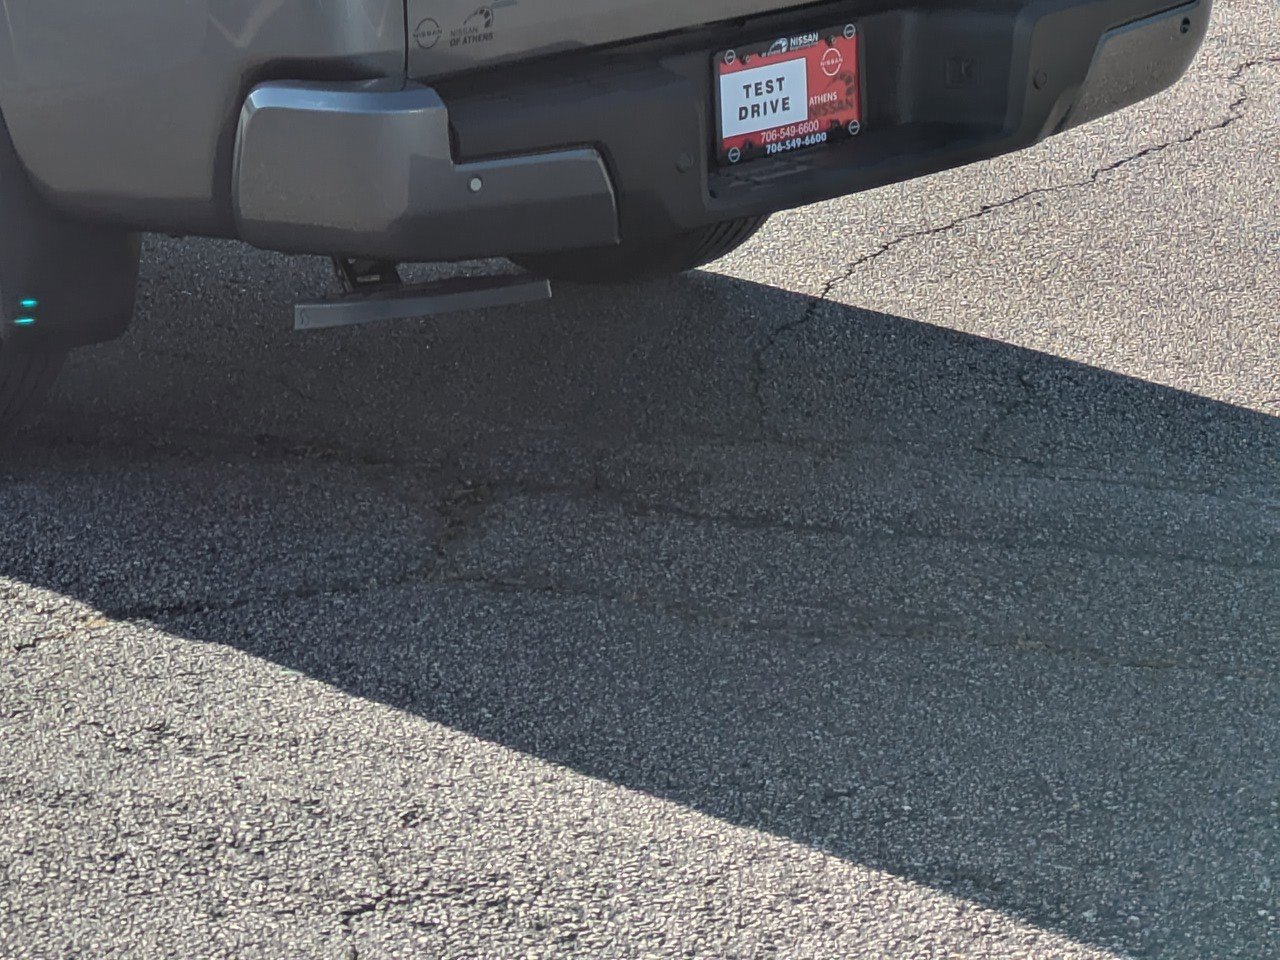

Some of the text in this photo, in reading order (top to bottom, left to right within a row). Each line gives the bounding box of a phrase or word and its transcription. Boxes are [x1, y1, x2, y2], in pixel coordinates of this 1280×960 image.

[449, 32, 494, 47] OF ATHENS
[789, 32, 819, 45] NISSAN
[742, 76, 786, 99] TEST
[808, 91, 838, 107] ATHENS
[738, 96, 791, 121] DRIVE
[761, 119, 819, 144] 706-549-6600
[766, 132, 827, 155] 706-549-6600
